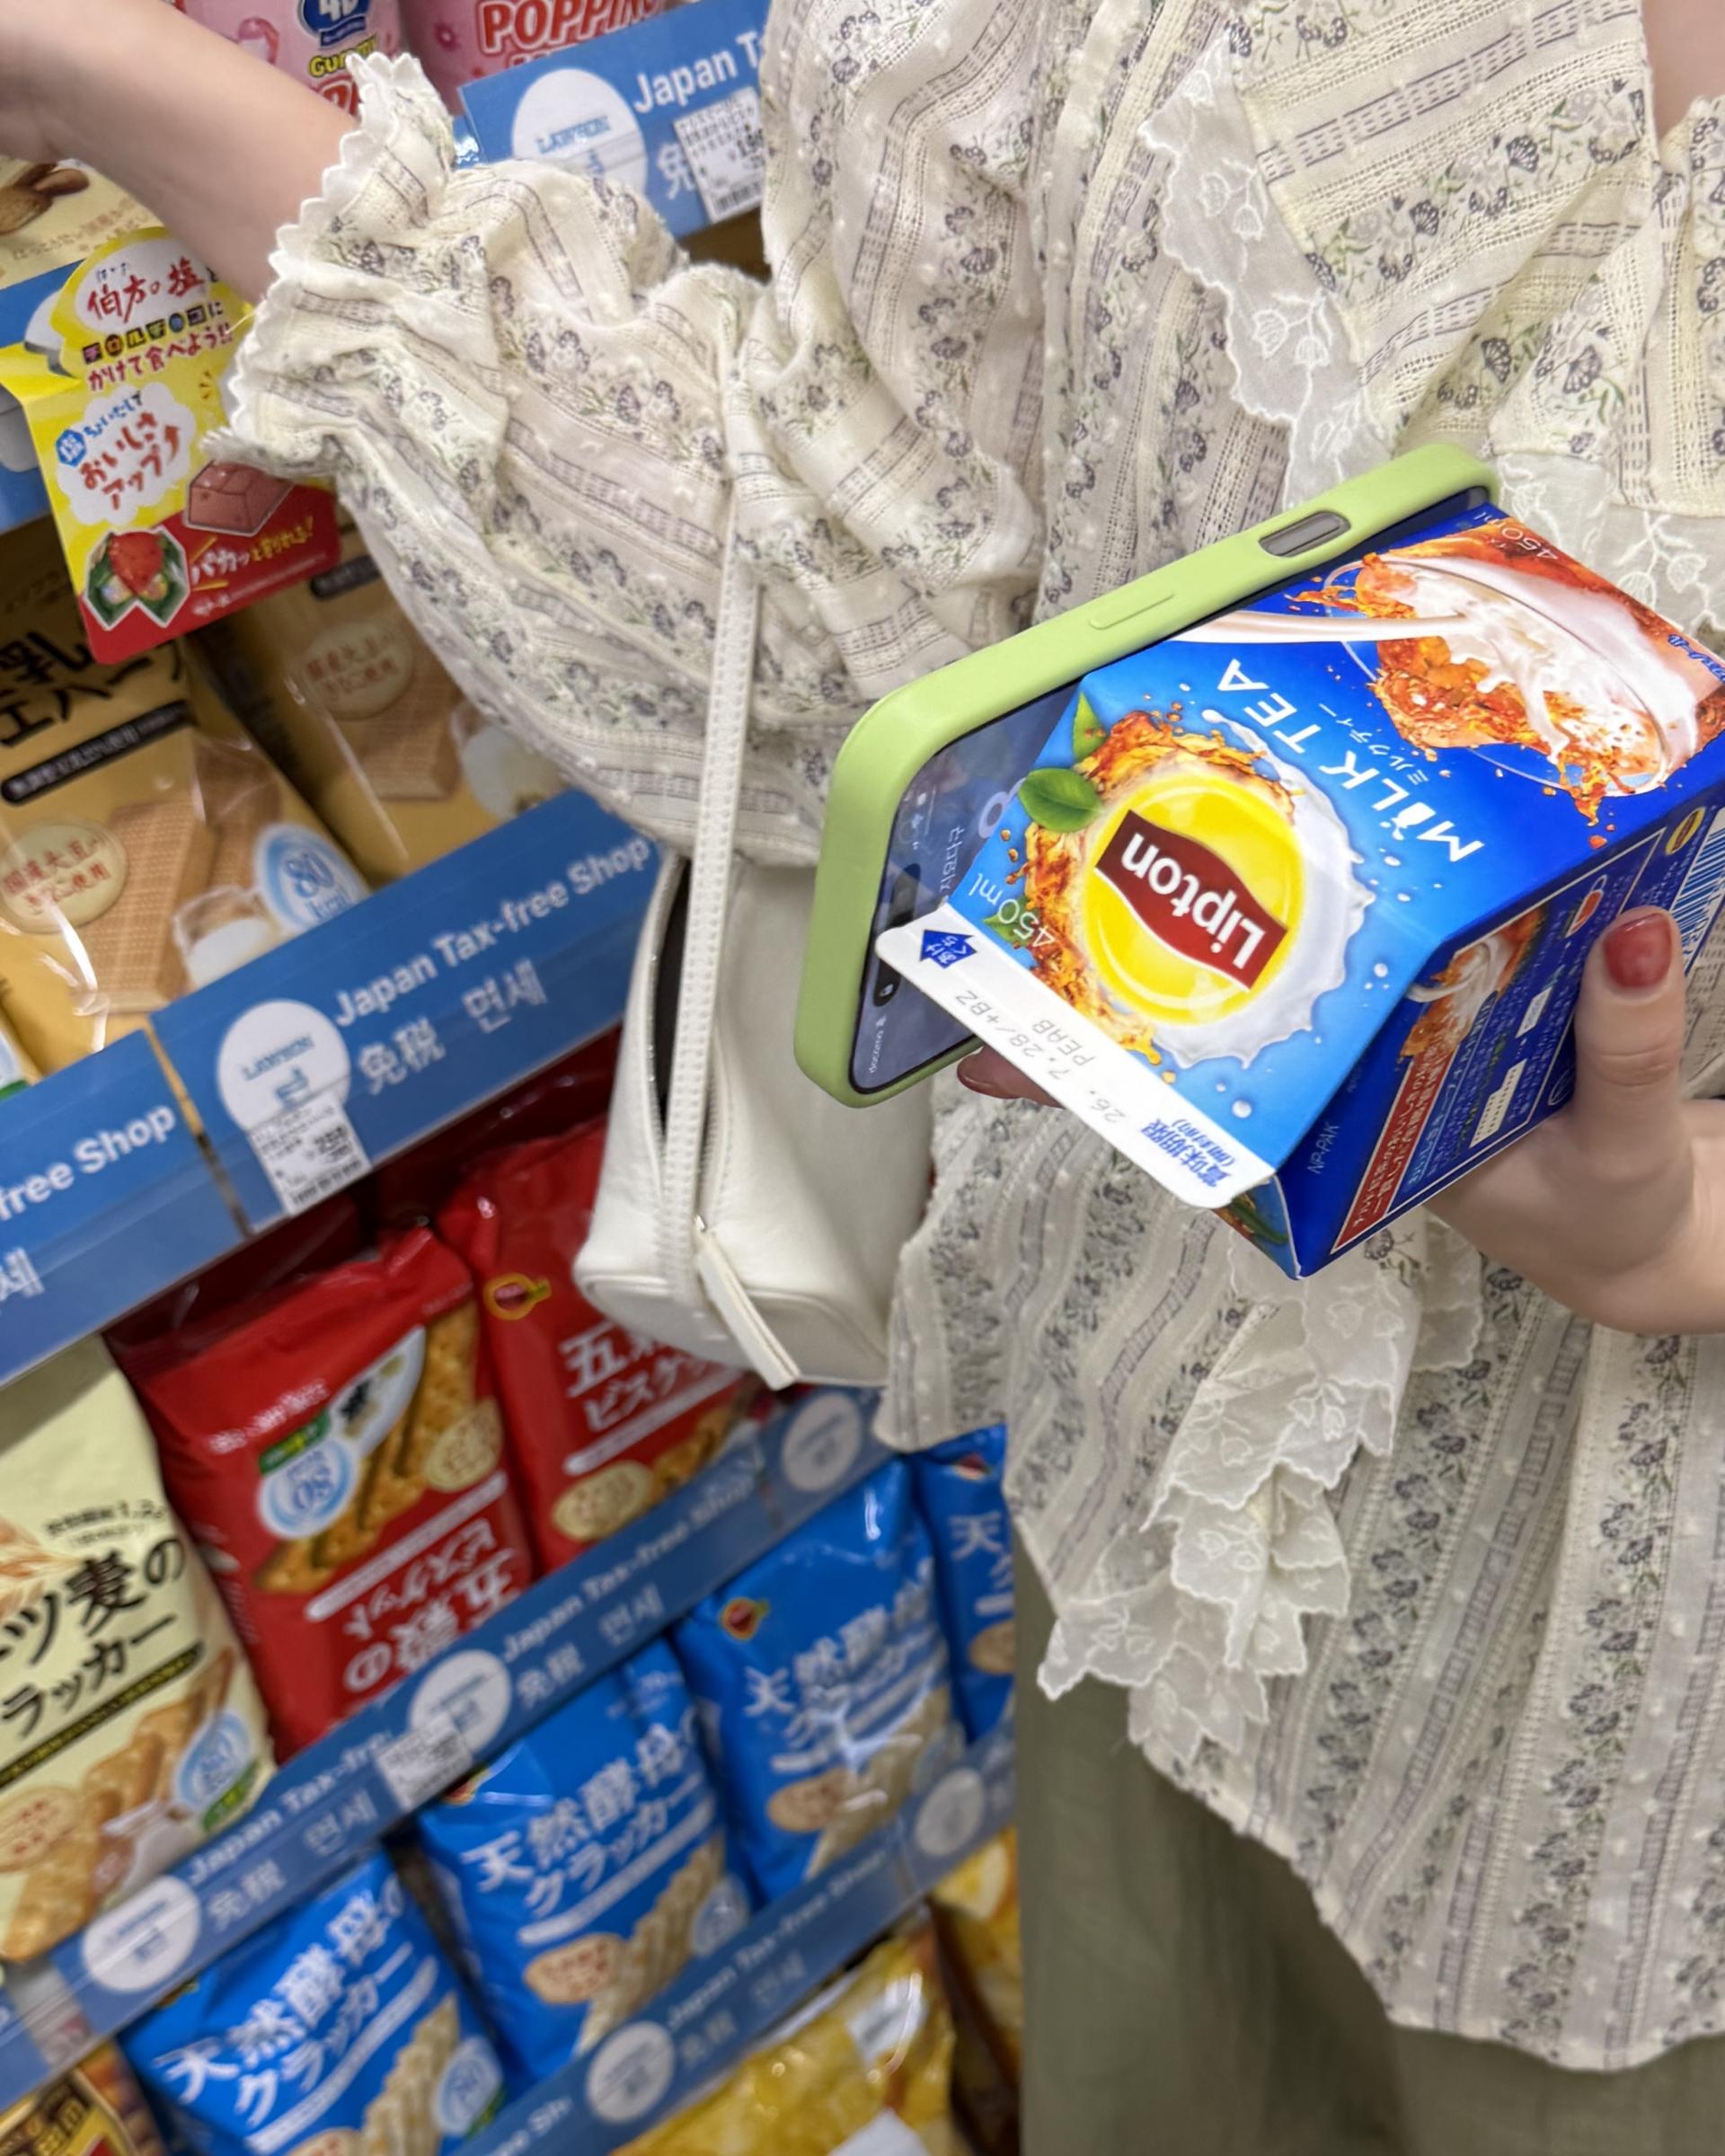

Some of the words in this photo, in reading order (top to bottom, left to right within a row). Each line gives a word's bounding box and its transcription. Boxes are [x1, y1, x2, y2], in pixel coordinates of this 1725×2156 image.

[633, 57, 738, 113] Japan
[737, 31, 762, 69] T
[1217, 658, 1322, 755] TEA
[1319, 702, 1429, 785] ミルクティー
[335, 954, 438, 1027] Japan
[431, 881, 569, 968] Tax-free
[567, 837, 650, 894] Shop
[967, 871, 1058, 950] 450ml
[1120, 832, 1266, 971] Lipton
[462, 958, 548, 1034] 면세
[73, 1106, 175, 1174] Shop
[1141, 1118, 1231, 1188] 賞味期限
[504, 1595, 583, 1663] Japan
[188, 1809, 284, 1886] Japan
